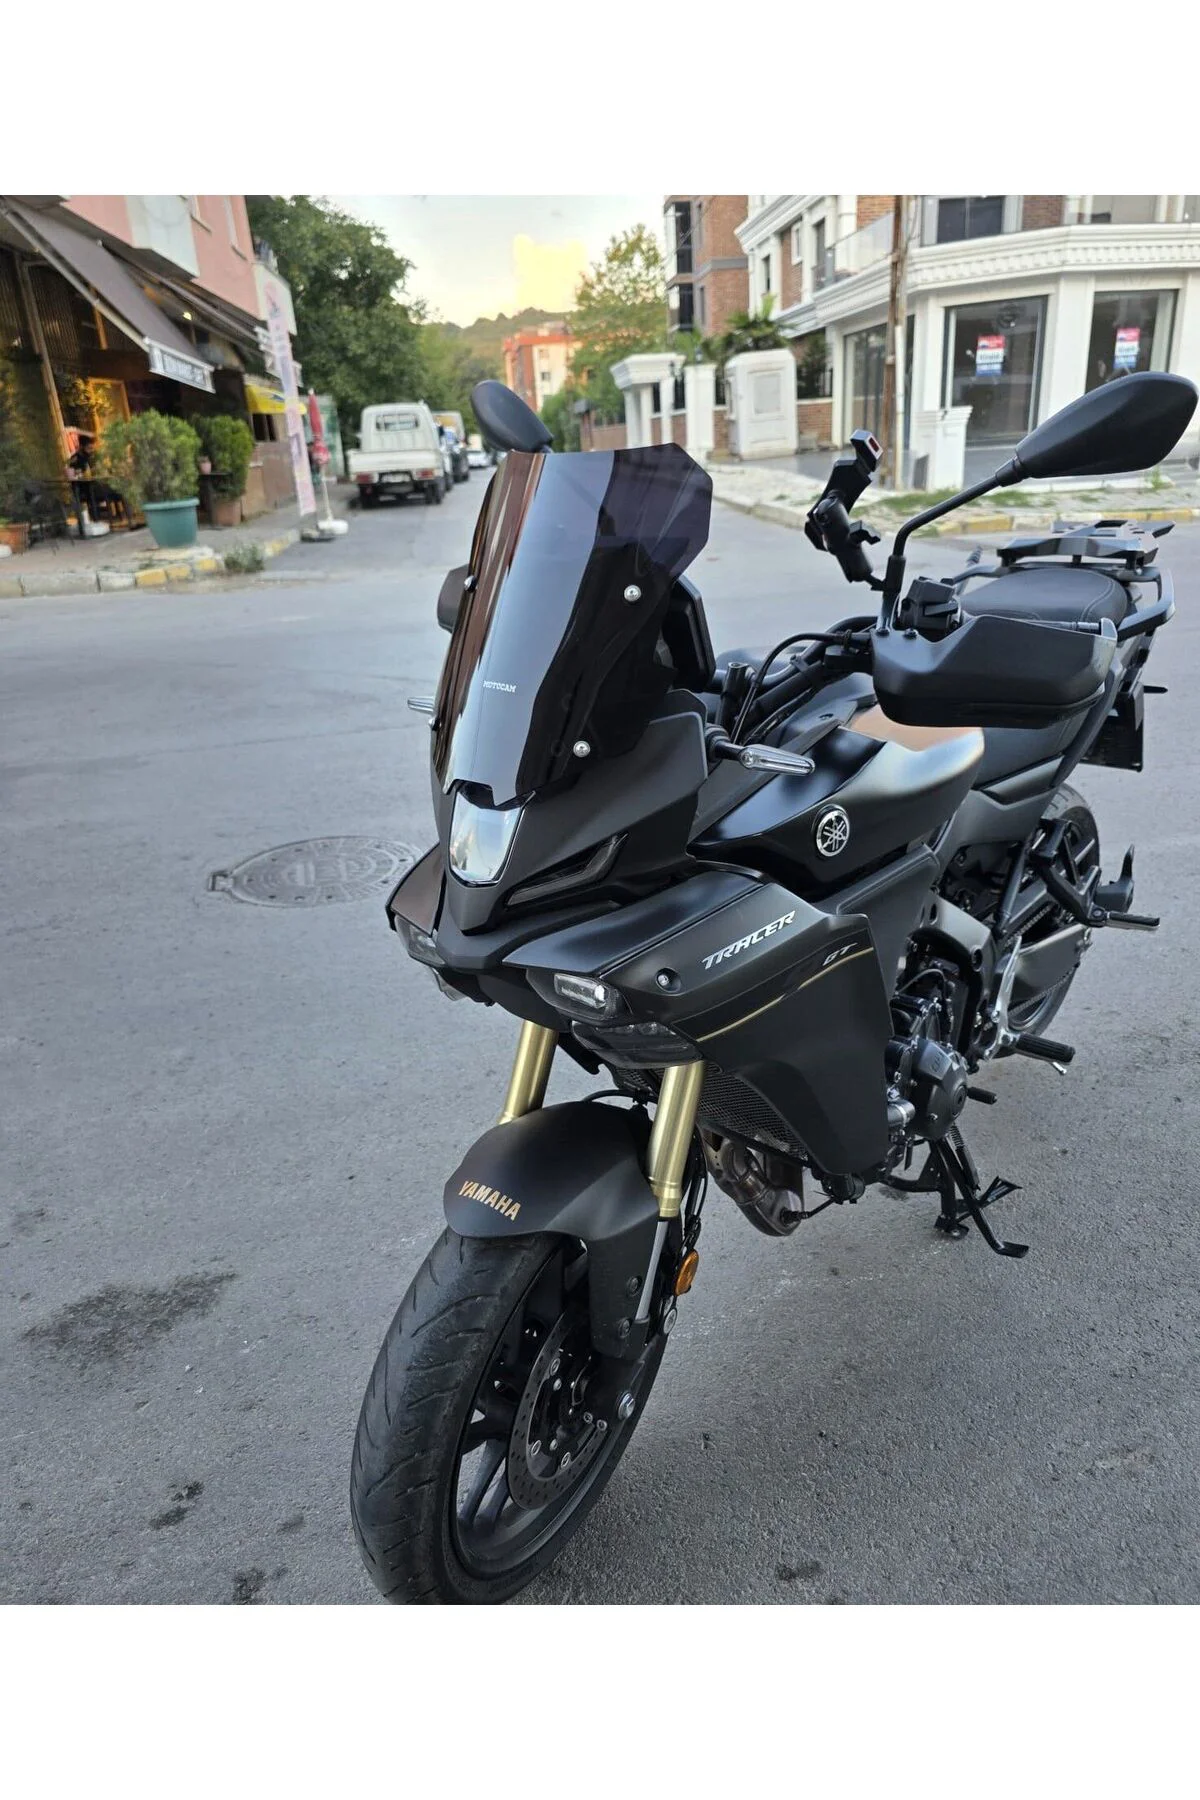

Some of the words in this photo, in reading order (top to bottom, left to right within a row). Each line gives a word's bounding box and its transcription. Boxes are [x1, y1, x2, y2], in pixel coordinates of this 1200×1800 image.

[701, 910, 796, 970] TRACER
[822, 942, 858, 966] GT
[458, 1180, 521, 1221] YAMAHA
